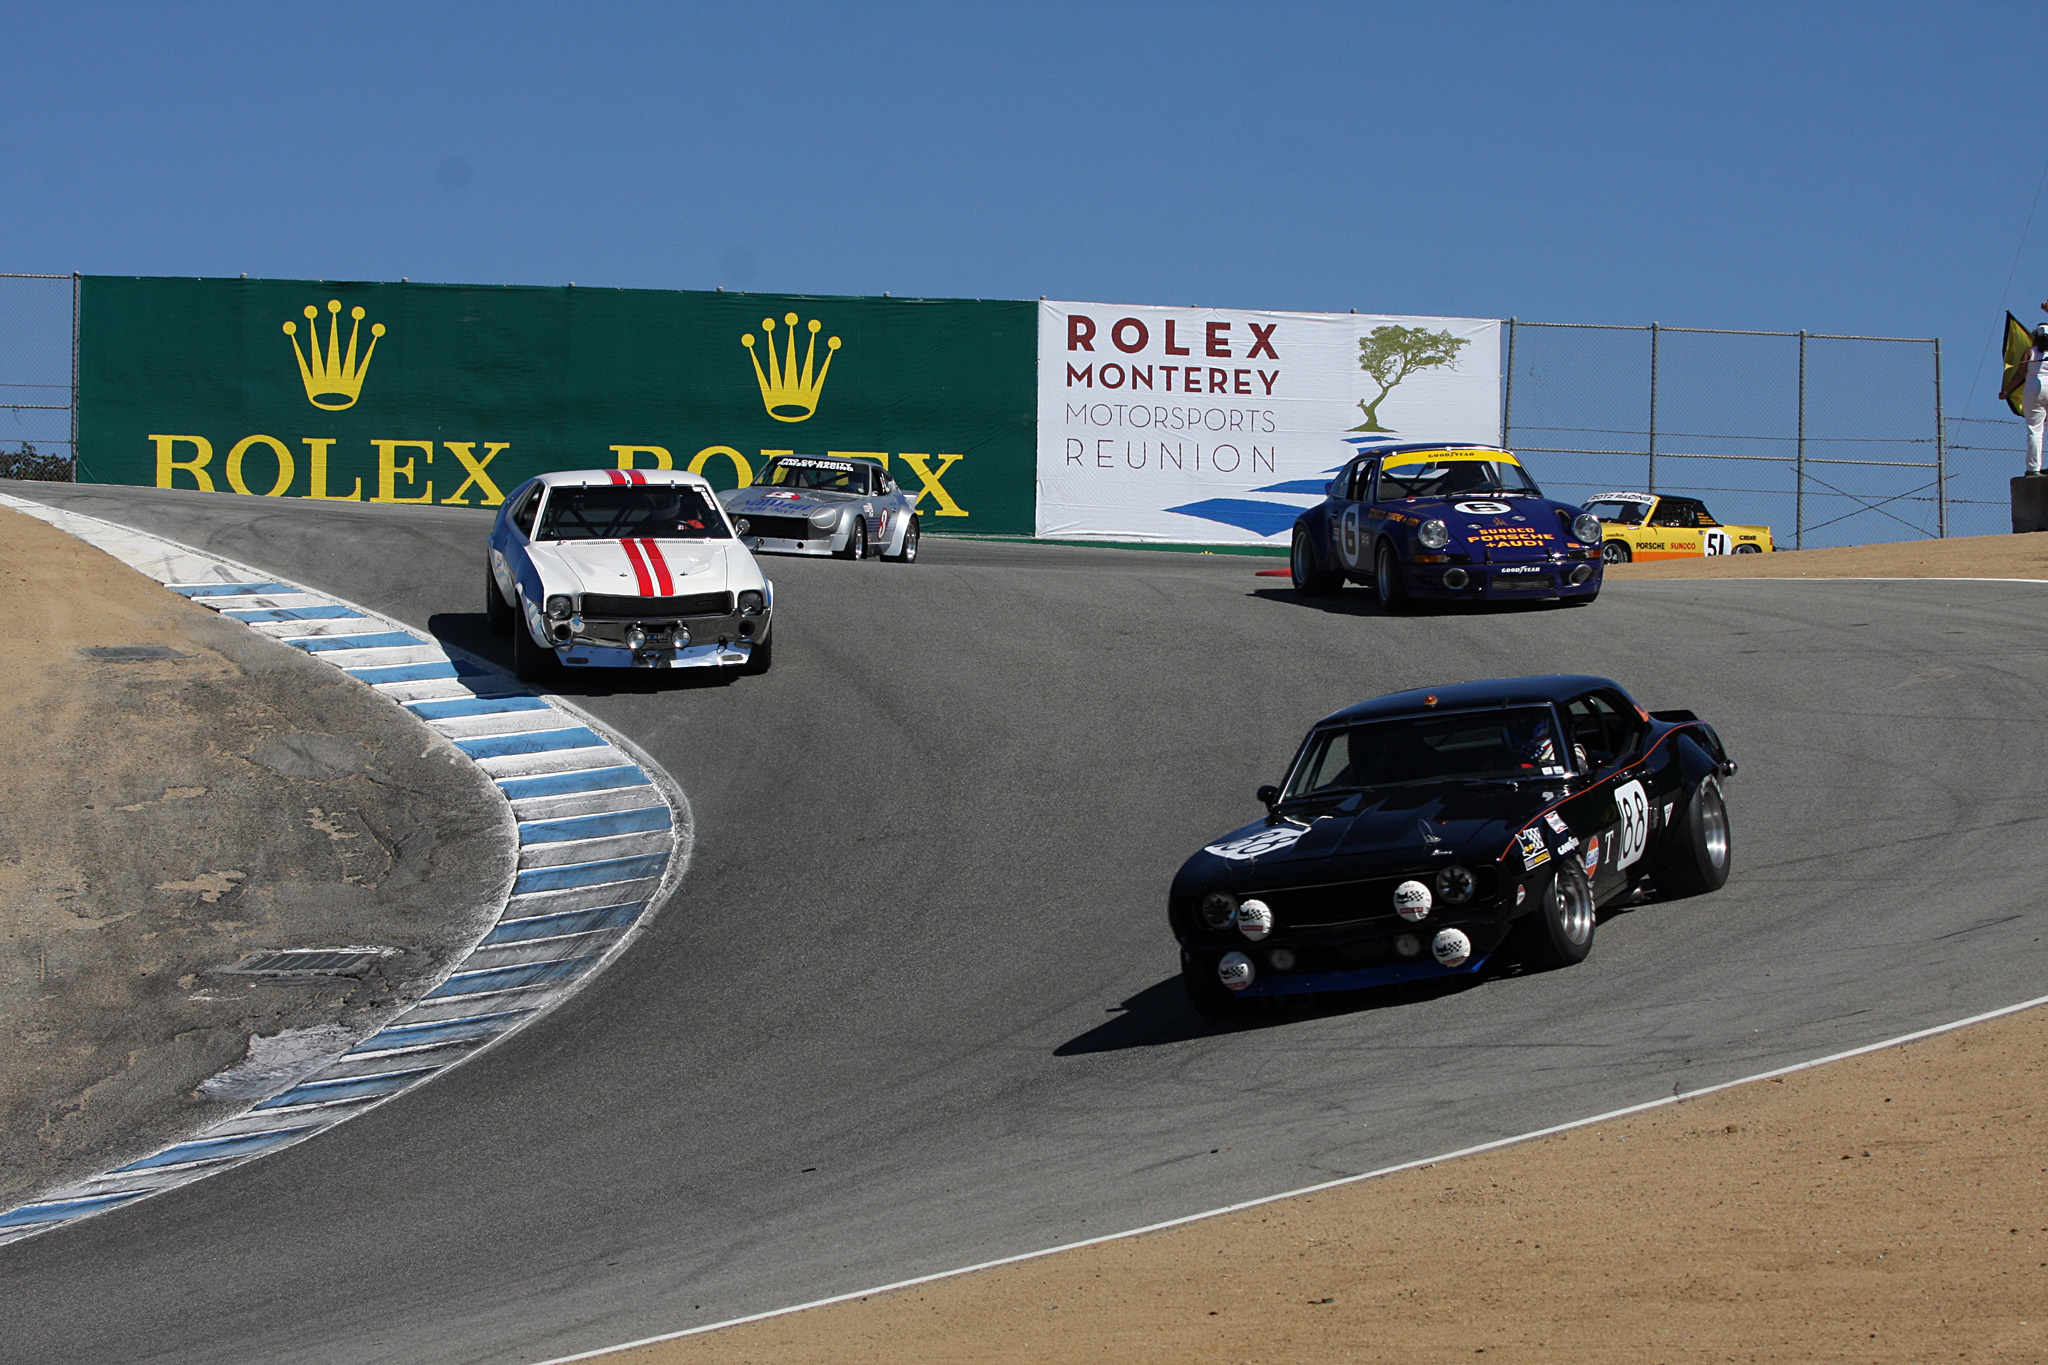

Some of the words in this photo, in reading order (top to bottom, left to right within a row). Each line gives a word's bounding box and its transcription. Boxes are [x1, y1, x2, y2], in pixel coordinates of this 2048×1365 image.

[1067, 315, 1279, 360] ROLEX
[1066, 362, 1279, 395] MONTEREY
[1066, 403, 1276, 433] MOTORSPORTS
[148, 434, 511, 506] ROLEX
[1066, 438, 1275, 474] REUNION
[1615, 494, 1651, 502] RACING
[878, 509, 888, 539] 3
[1345, 512, 1356, 556] 6
[1467, 533, 1555, 543] PORSCHE
[1636, 542, 1665, 550] PORSCHE
[1670, 542, 1697, 550] SUNOCO
[1708, 533, 1725, 556] 51
[1501, 565, 1541, 574] GOODYEAR
